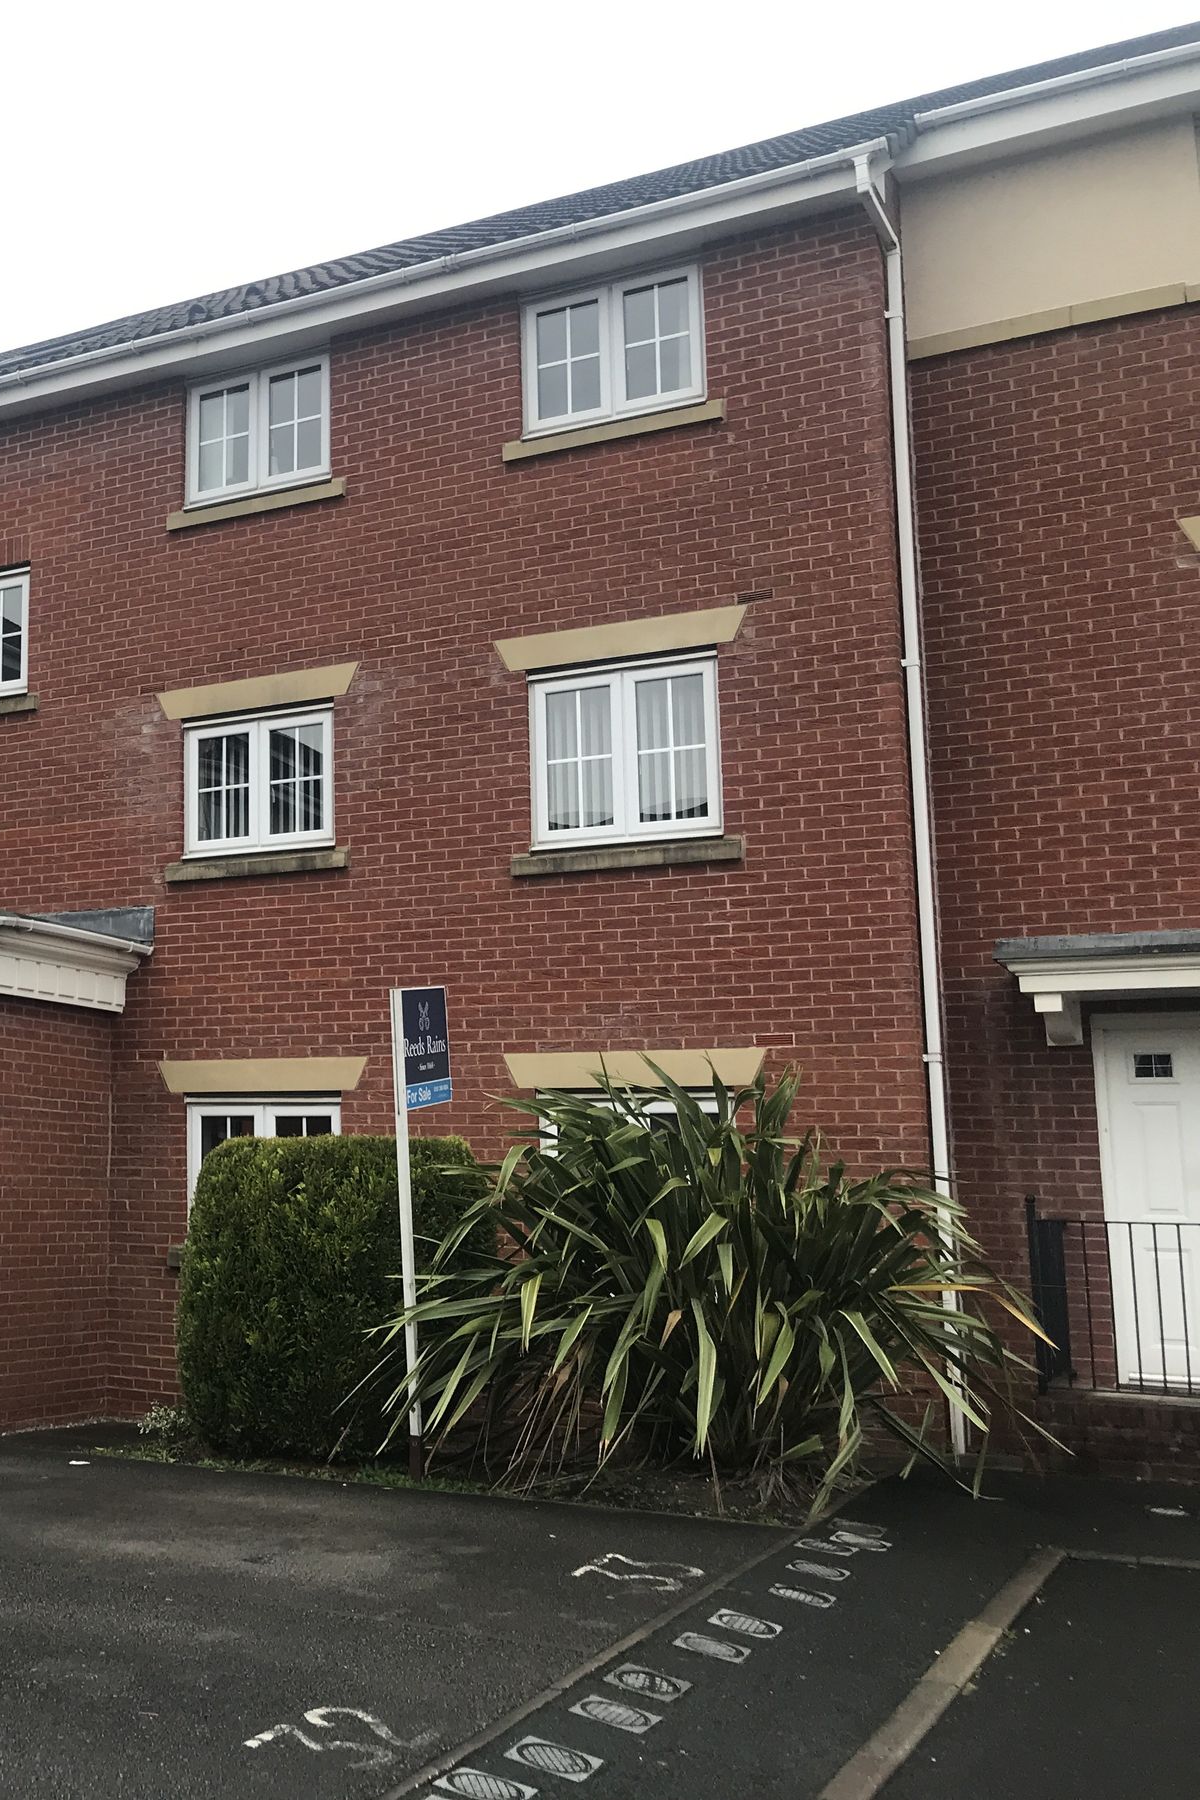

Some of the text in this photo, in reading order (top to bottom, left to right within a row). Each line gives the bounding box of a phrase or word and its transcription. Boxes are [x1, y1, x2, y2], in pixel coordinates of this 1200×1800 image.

[403, 1035, 446, 1058] Reeds Rains
[407, 1090, 418, 1104] For
[418, 1086, 432, 1102] Sale
